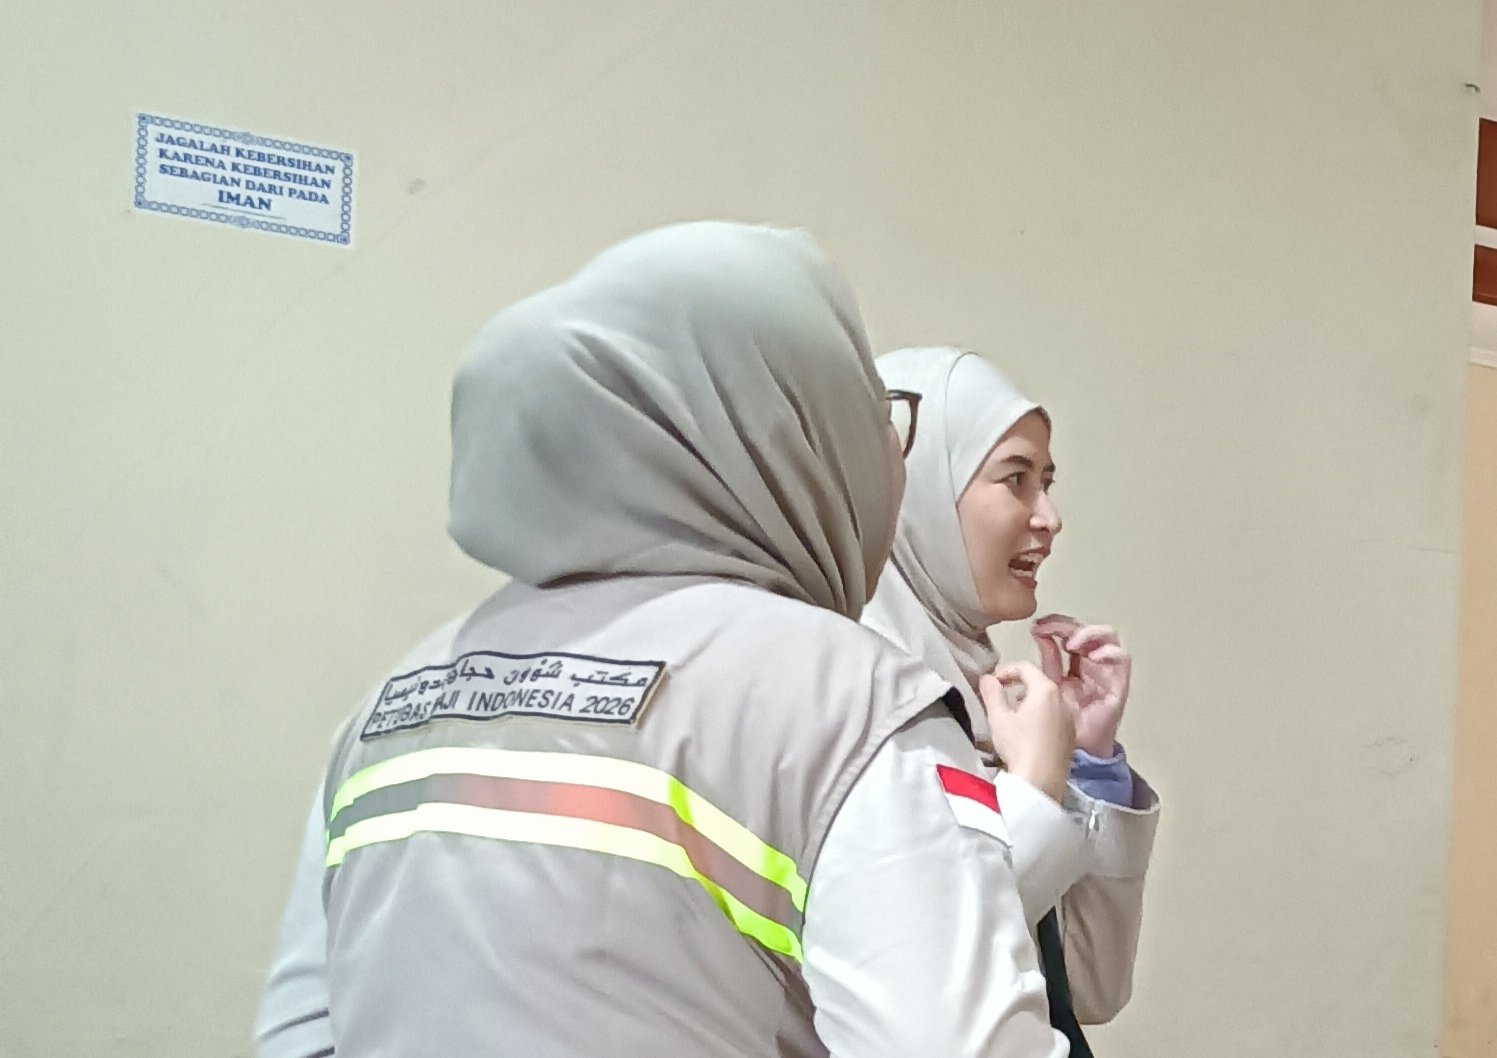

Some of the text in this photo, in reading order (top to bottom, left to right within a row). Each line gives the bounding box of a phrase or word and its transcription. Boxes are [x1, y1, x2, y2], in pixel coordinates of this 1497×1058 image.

[155, 133, 336, 175] JAGALAH KEBERSIHAN
[158, 148, 331, 189] KARENA KEBERSIHAN
[158, 163, 330, 205] SEBAGIAN DARI PADA
[218, 190, 272, 211] IMAN
[570, 670, 648, 687] مكتب
[466, 688, 574, 713] INDONESIA
[578, 695, 636, 716] 2026
